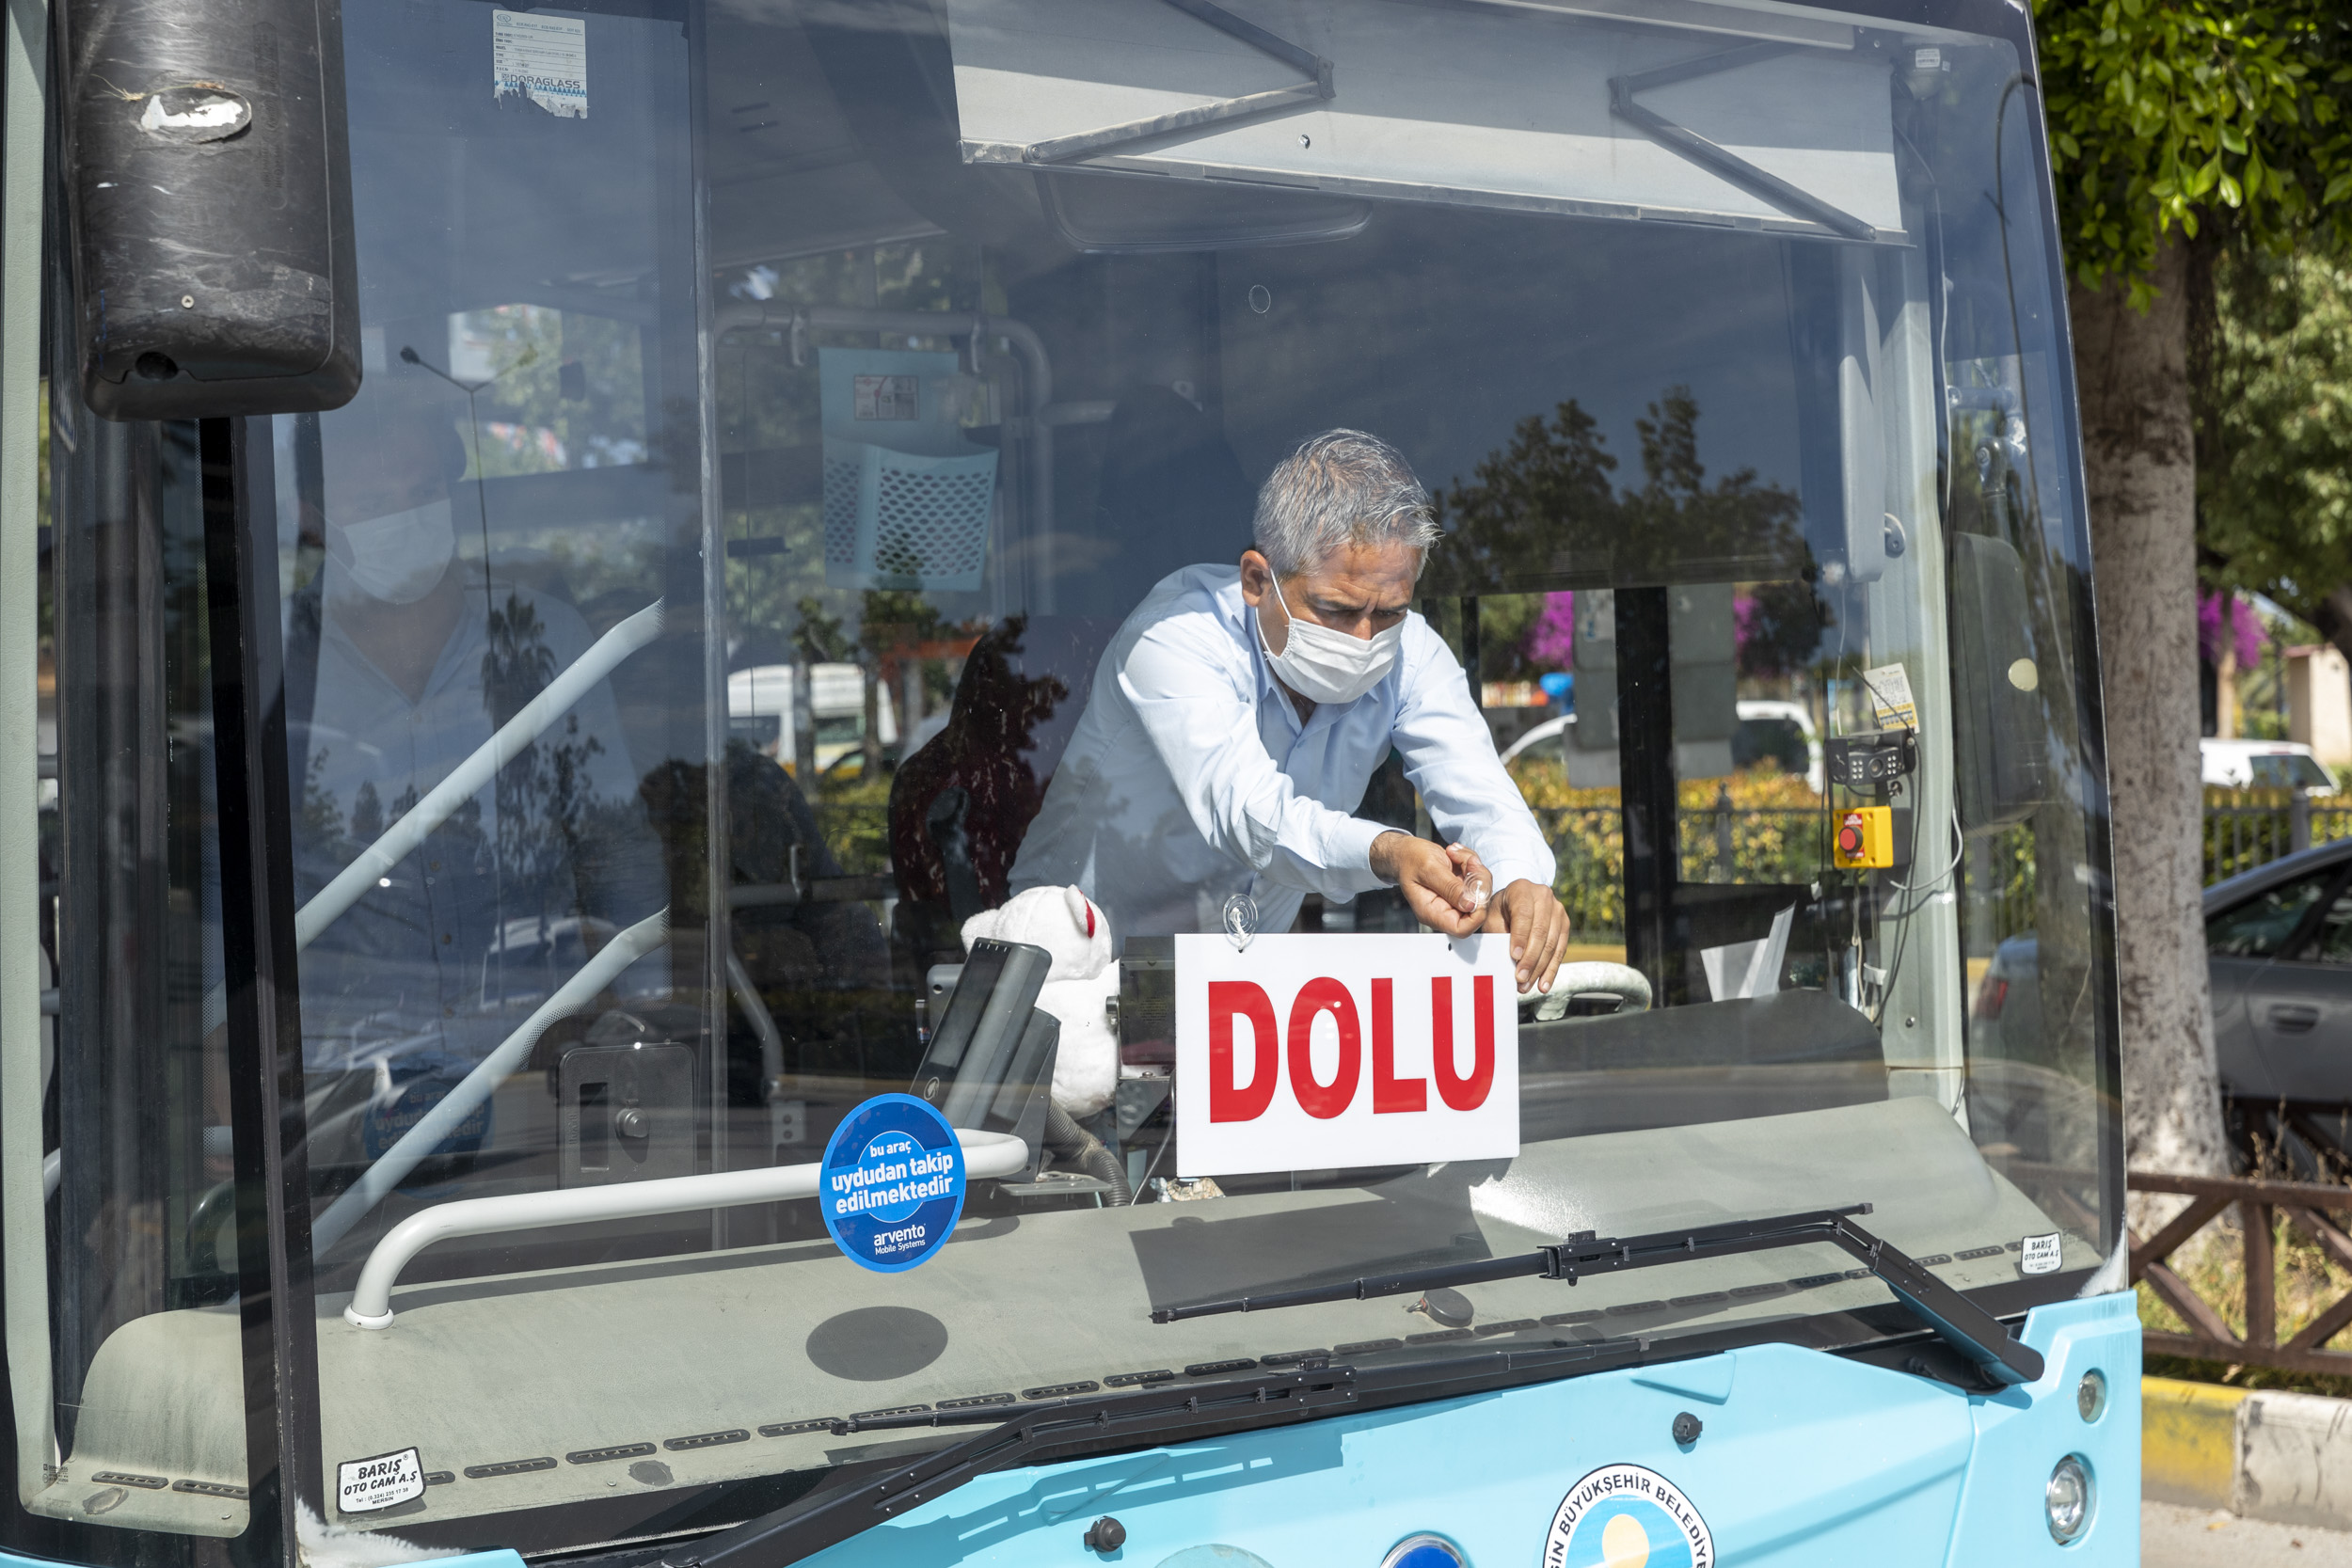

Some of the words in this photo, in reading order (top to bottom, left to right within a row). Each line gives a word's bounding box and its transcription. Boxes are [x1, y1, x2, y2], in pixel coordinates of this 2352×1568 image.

[510, 74, 580, 89] DORAGLASS
[1208, 974, 1495, 1123] DOLU
[869, 1144, 884, 1158] bu
[886, 1140, 912, 1153] araç
[832, 1164, 907, 1195] uydudan
[910, 1152, 954, 1177] takip
[835, 1176, 954, 1214] edilmektedir
[873, 1225, 926, 1246] arvento
[875, 1243, 896, 1255] Mobile
[898, 1239, 926, 1251] Systems
[358, 1458, 403, 1479] BARIŞ
[344, 1482, 367, 1496] OTO
[371, 1476, 395, 1490] CAM
[399, 1471, 418, 1483] A.Ş
[1559, 1472, 1651, 1535] BÜYÜKŞEHİR
